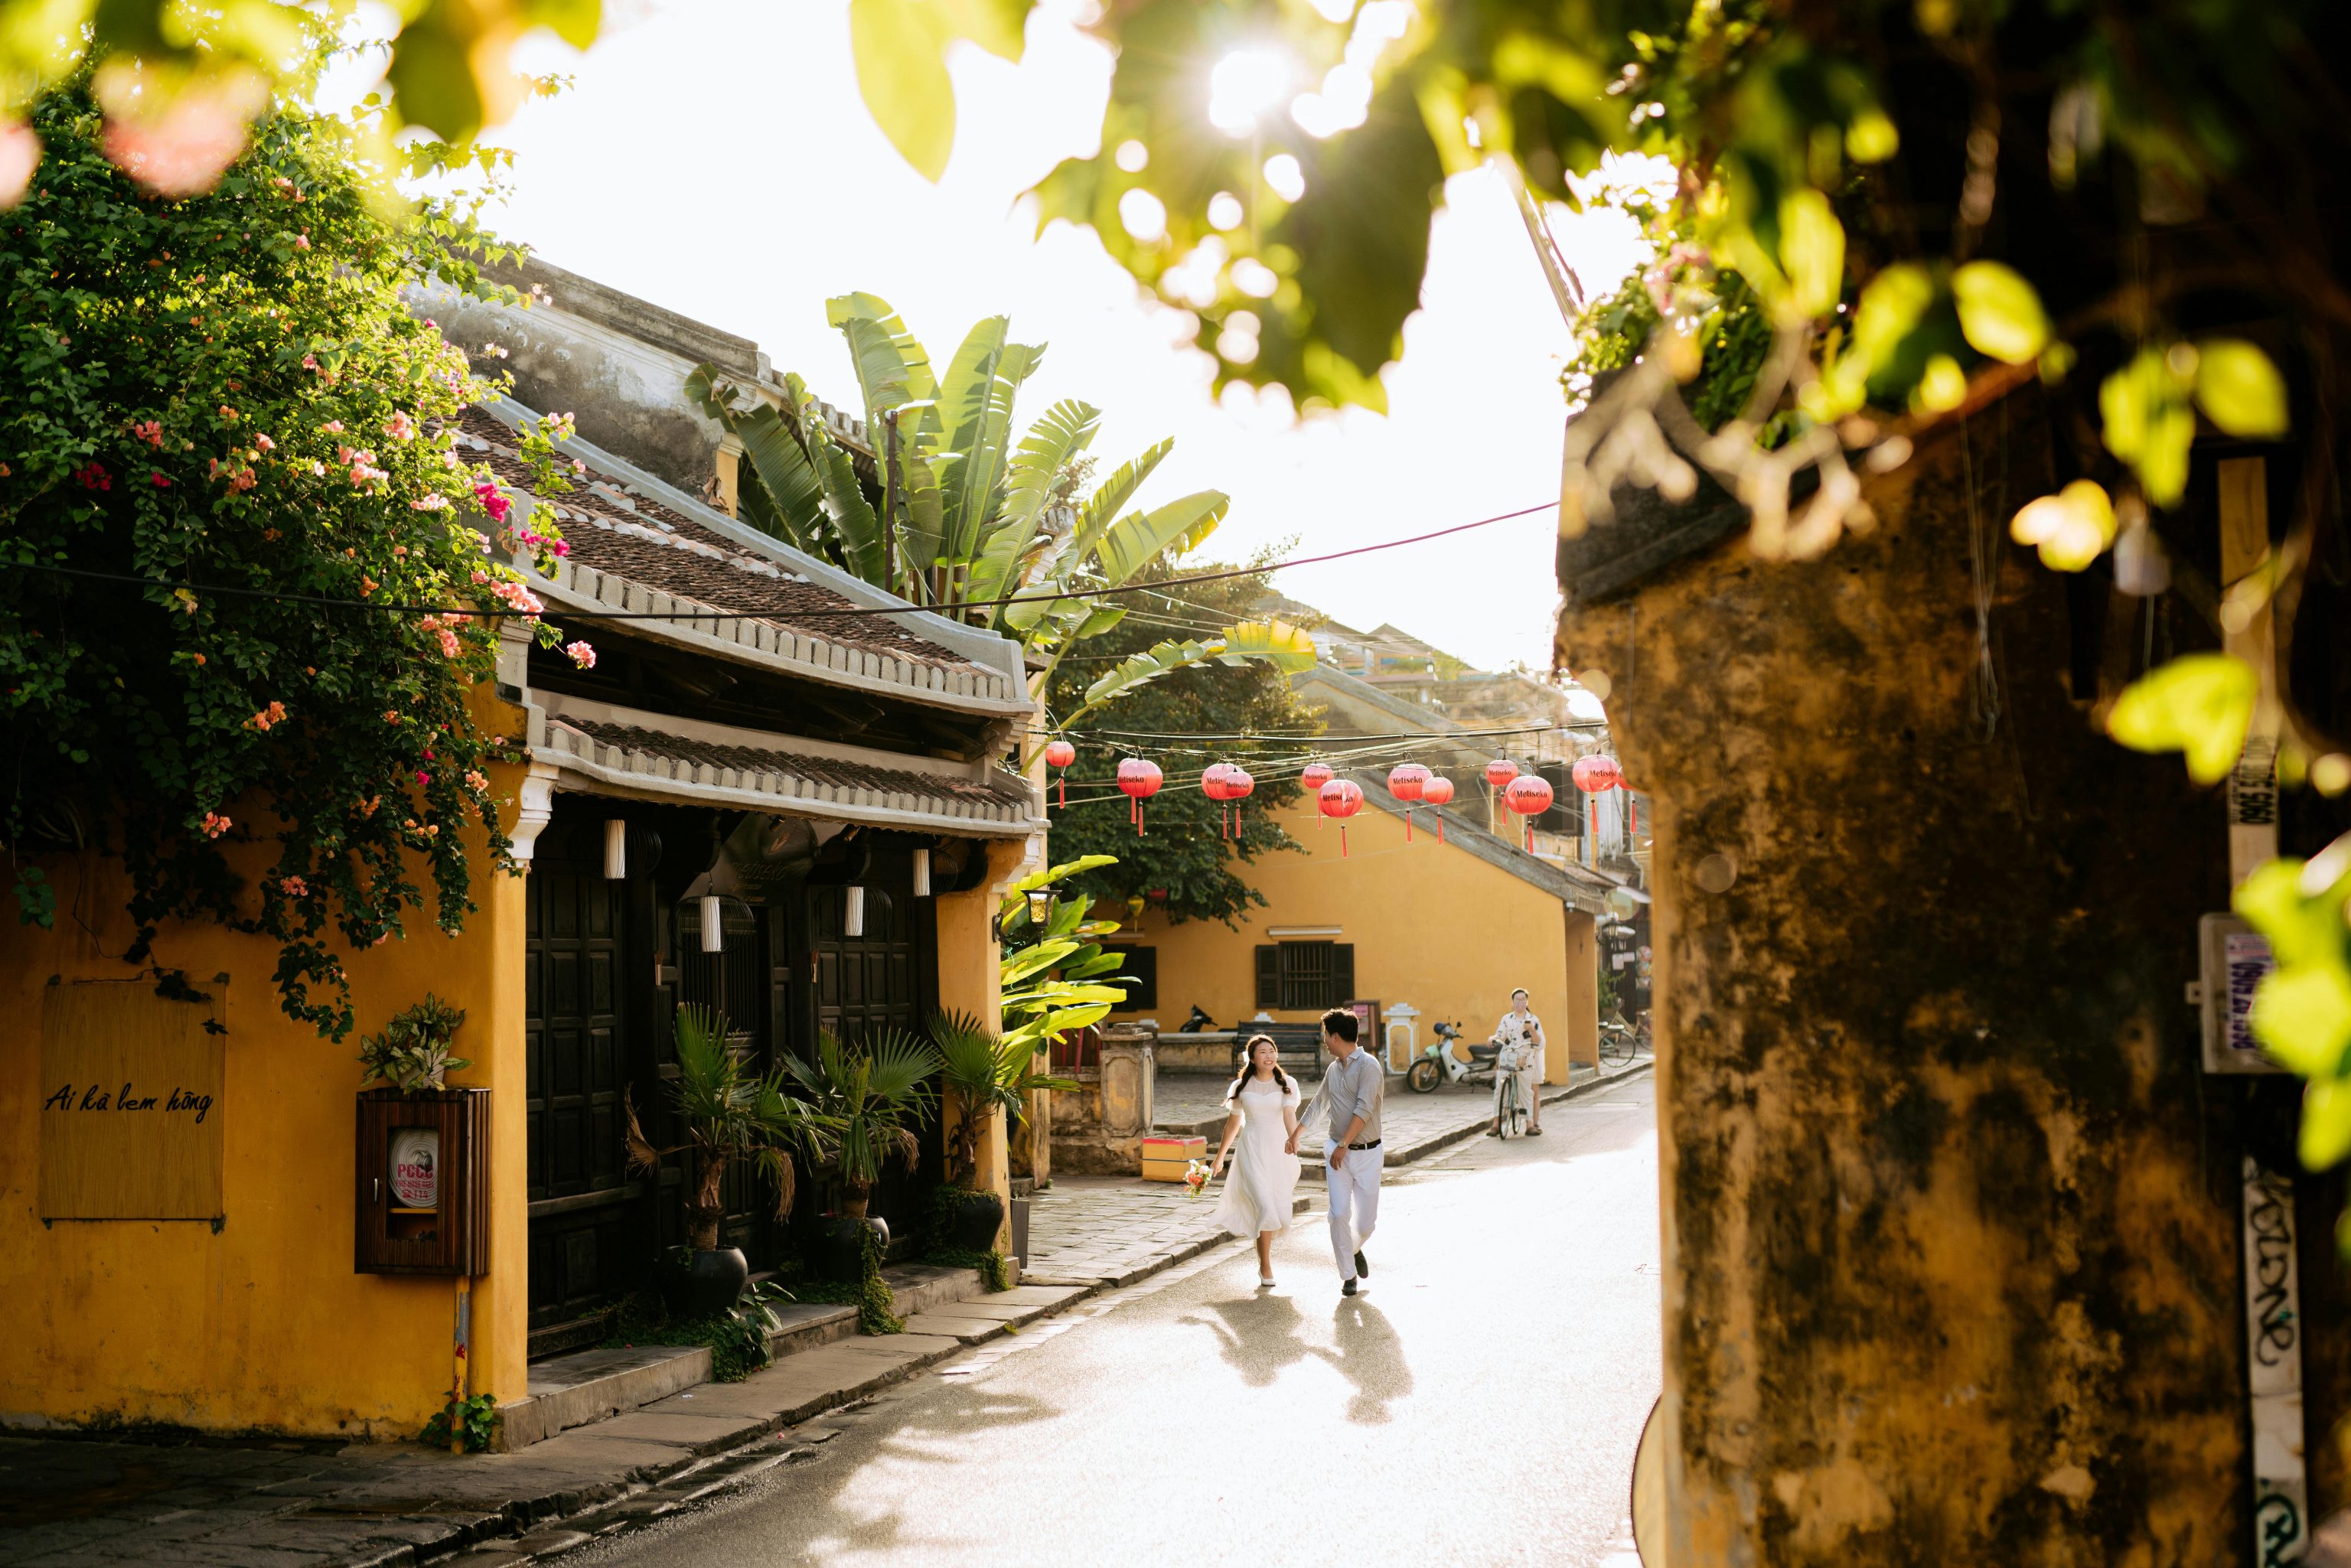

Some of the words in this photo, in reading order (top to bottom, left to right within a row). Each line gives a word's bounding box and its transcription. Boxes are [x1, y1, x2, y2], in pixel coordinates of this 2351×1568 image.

[1590, 768, 1617, 777] Metisek
[1118, 775, 1145, 784] Metiseko
[1393, 776, 1423, 785] Metiseko
[1516, 789, 1547, 799] Metiseko
[44, 1084, 77, 1111] Ai
[79, 1084, 111, 1111] kà
[117, 1082, 158, 1111] lem
[397, 1163, 434, 1178] PCCC
[414, 1190, 429, 1200] 114
